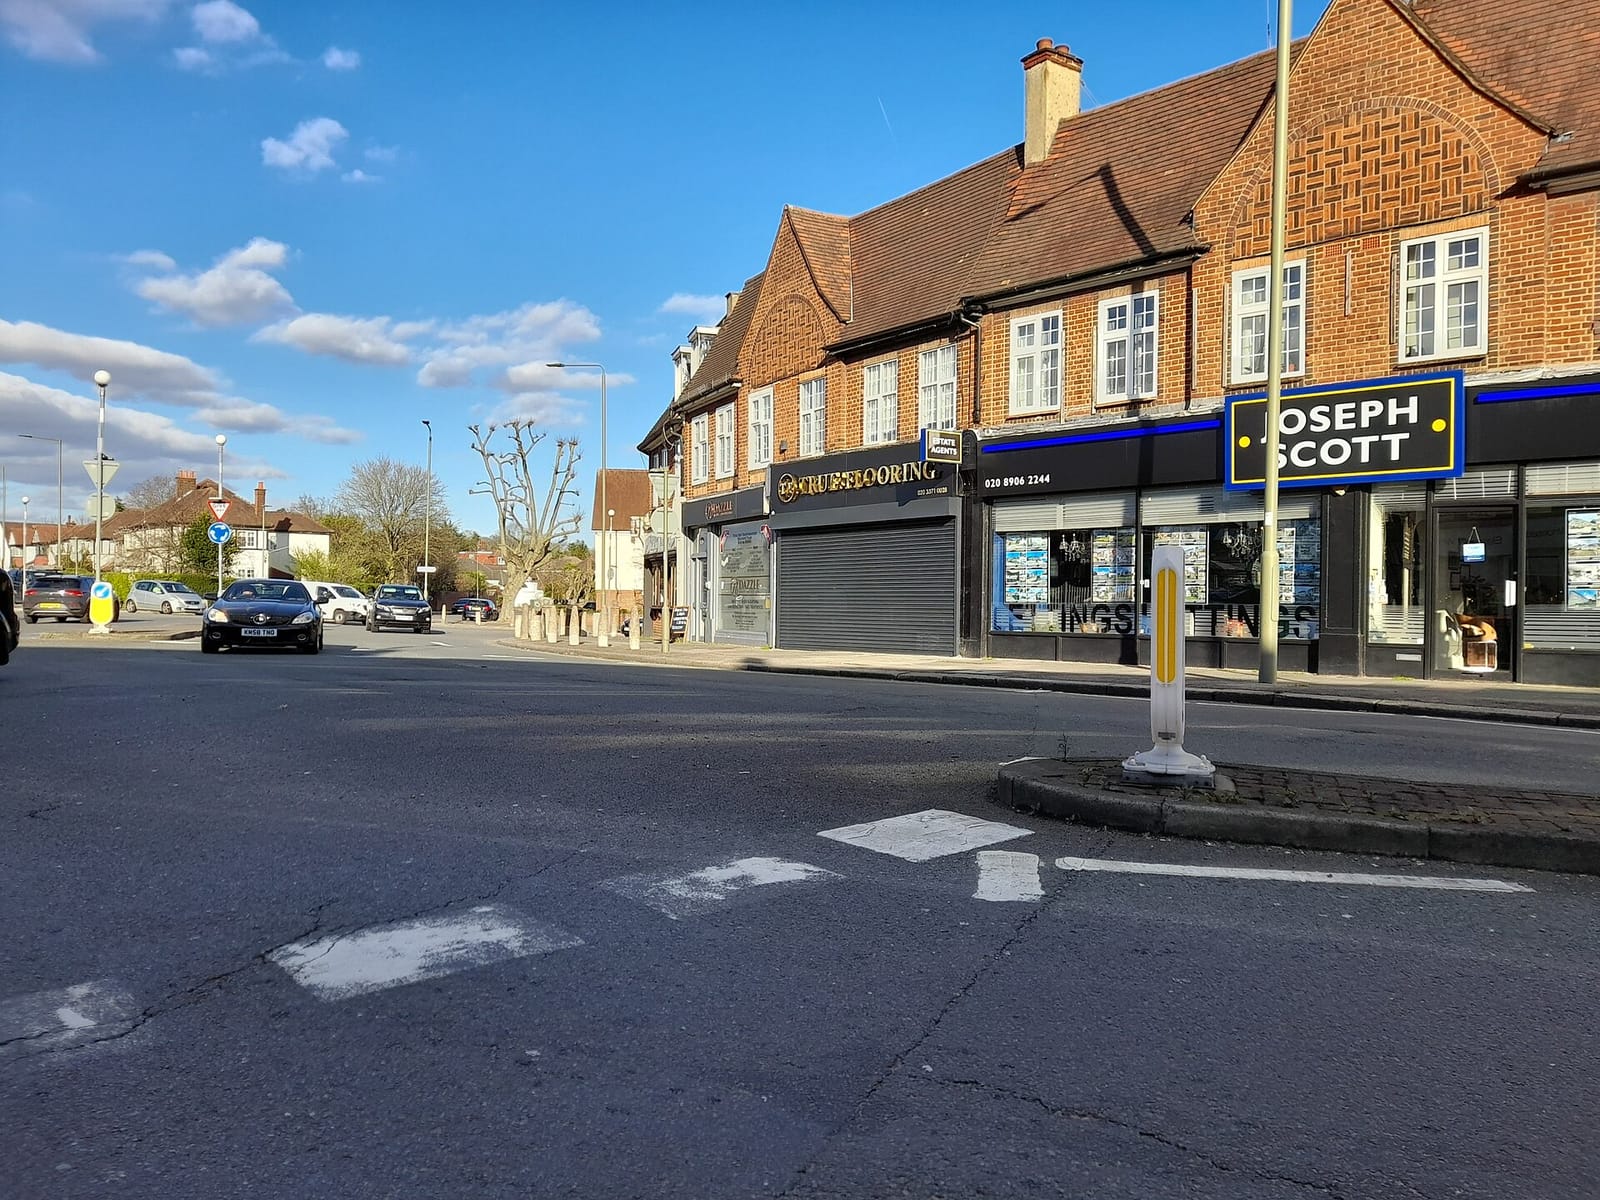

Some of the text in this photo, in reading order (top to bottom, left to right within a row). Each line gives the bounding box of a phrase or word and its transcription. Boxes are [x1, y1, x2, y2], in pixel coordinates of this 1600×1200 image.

[932, 437, 956, 447] ESTATE
[931, 446, 957, 456] AGENTS
[799, 461, 936, 495] TRUE FLOORING
[985, 473, 1050, 489] 020 8906 2244
